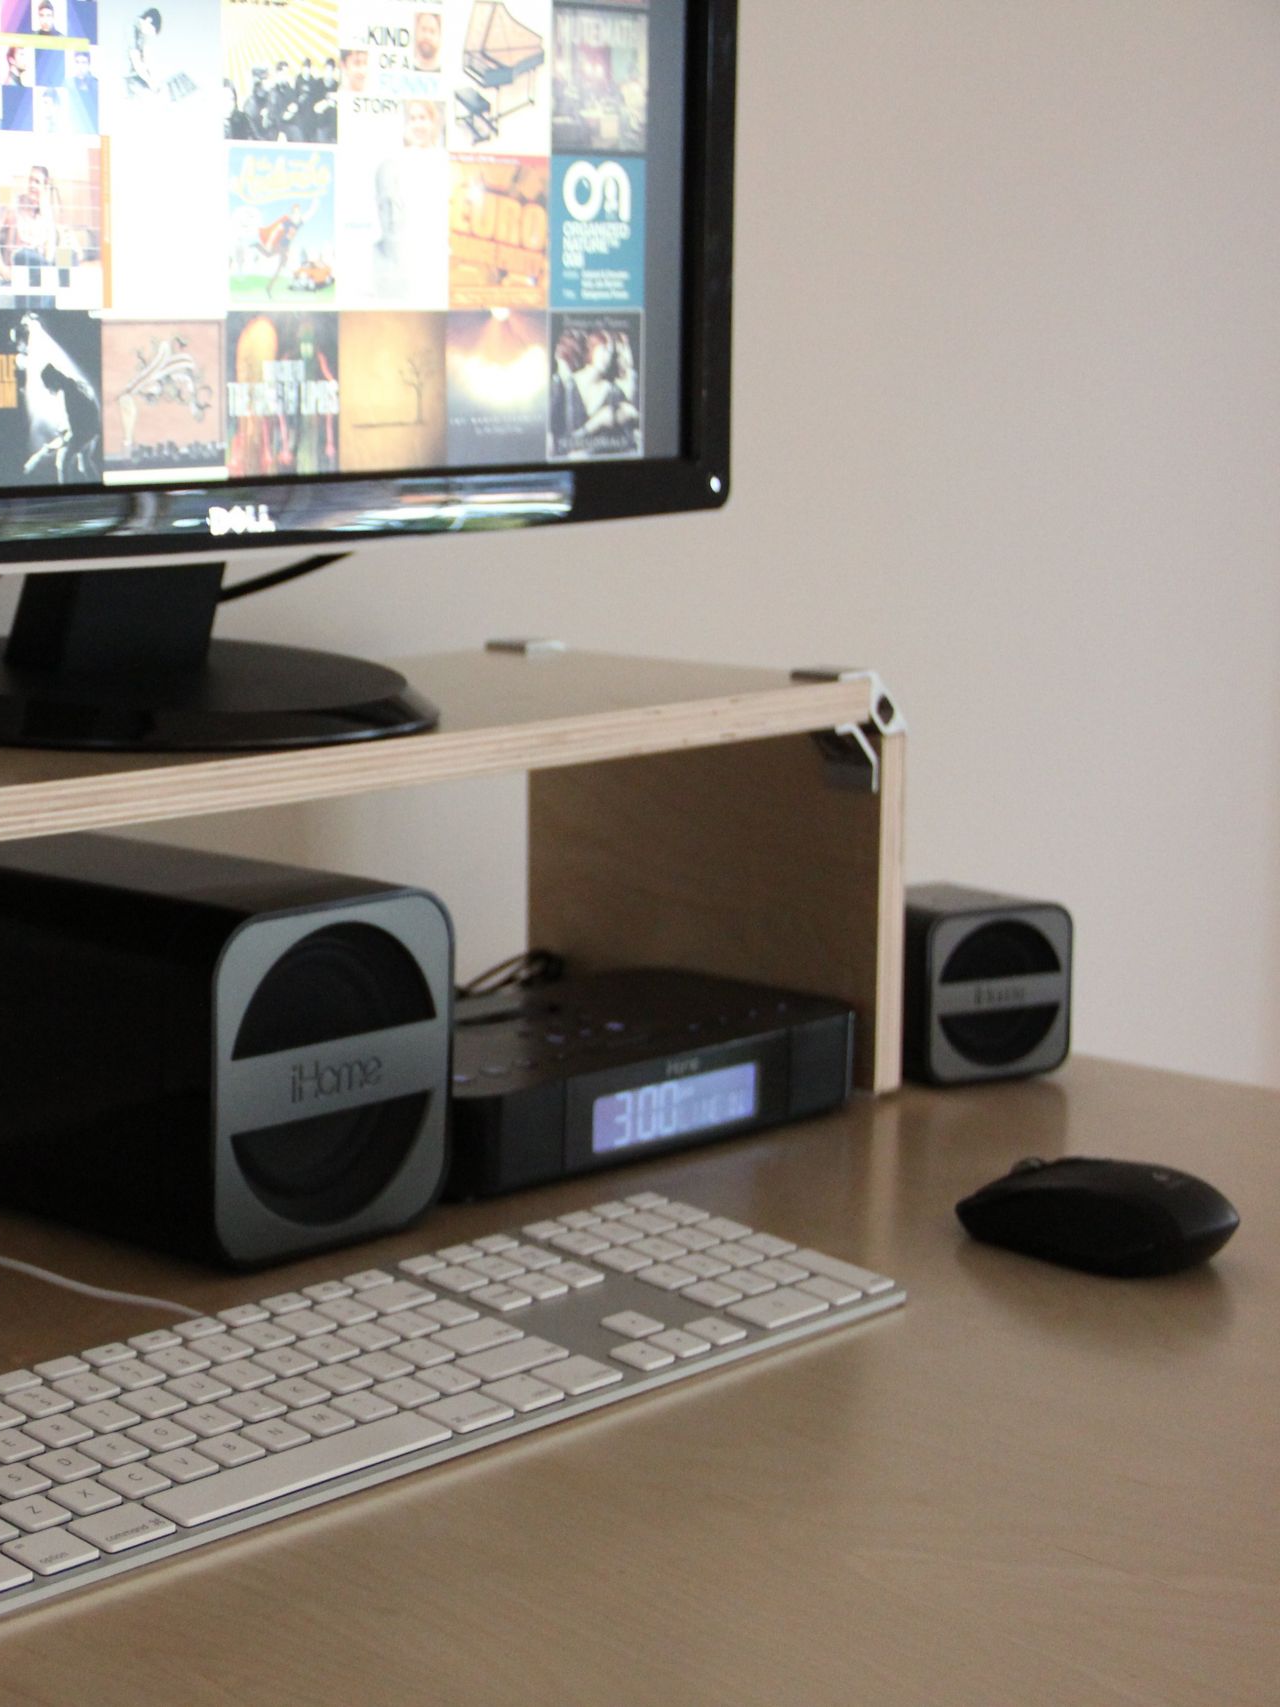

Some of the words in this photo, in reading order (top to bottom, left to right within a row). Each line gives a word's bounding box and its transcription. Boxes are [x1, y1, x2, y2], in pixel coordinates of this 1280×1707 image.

[367, 26, 411, 48] KIND
[378, 53, 397, 69] OF
[402, 55, 410, 70] A
[353, 96, 399, 114] STORY
[449, 184, 547, 250] EURO
[209, 504, 276, 536] DELL
[291, 1056, 383, 1104] iHome
